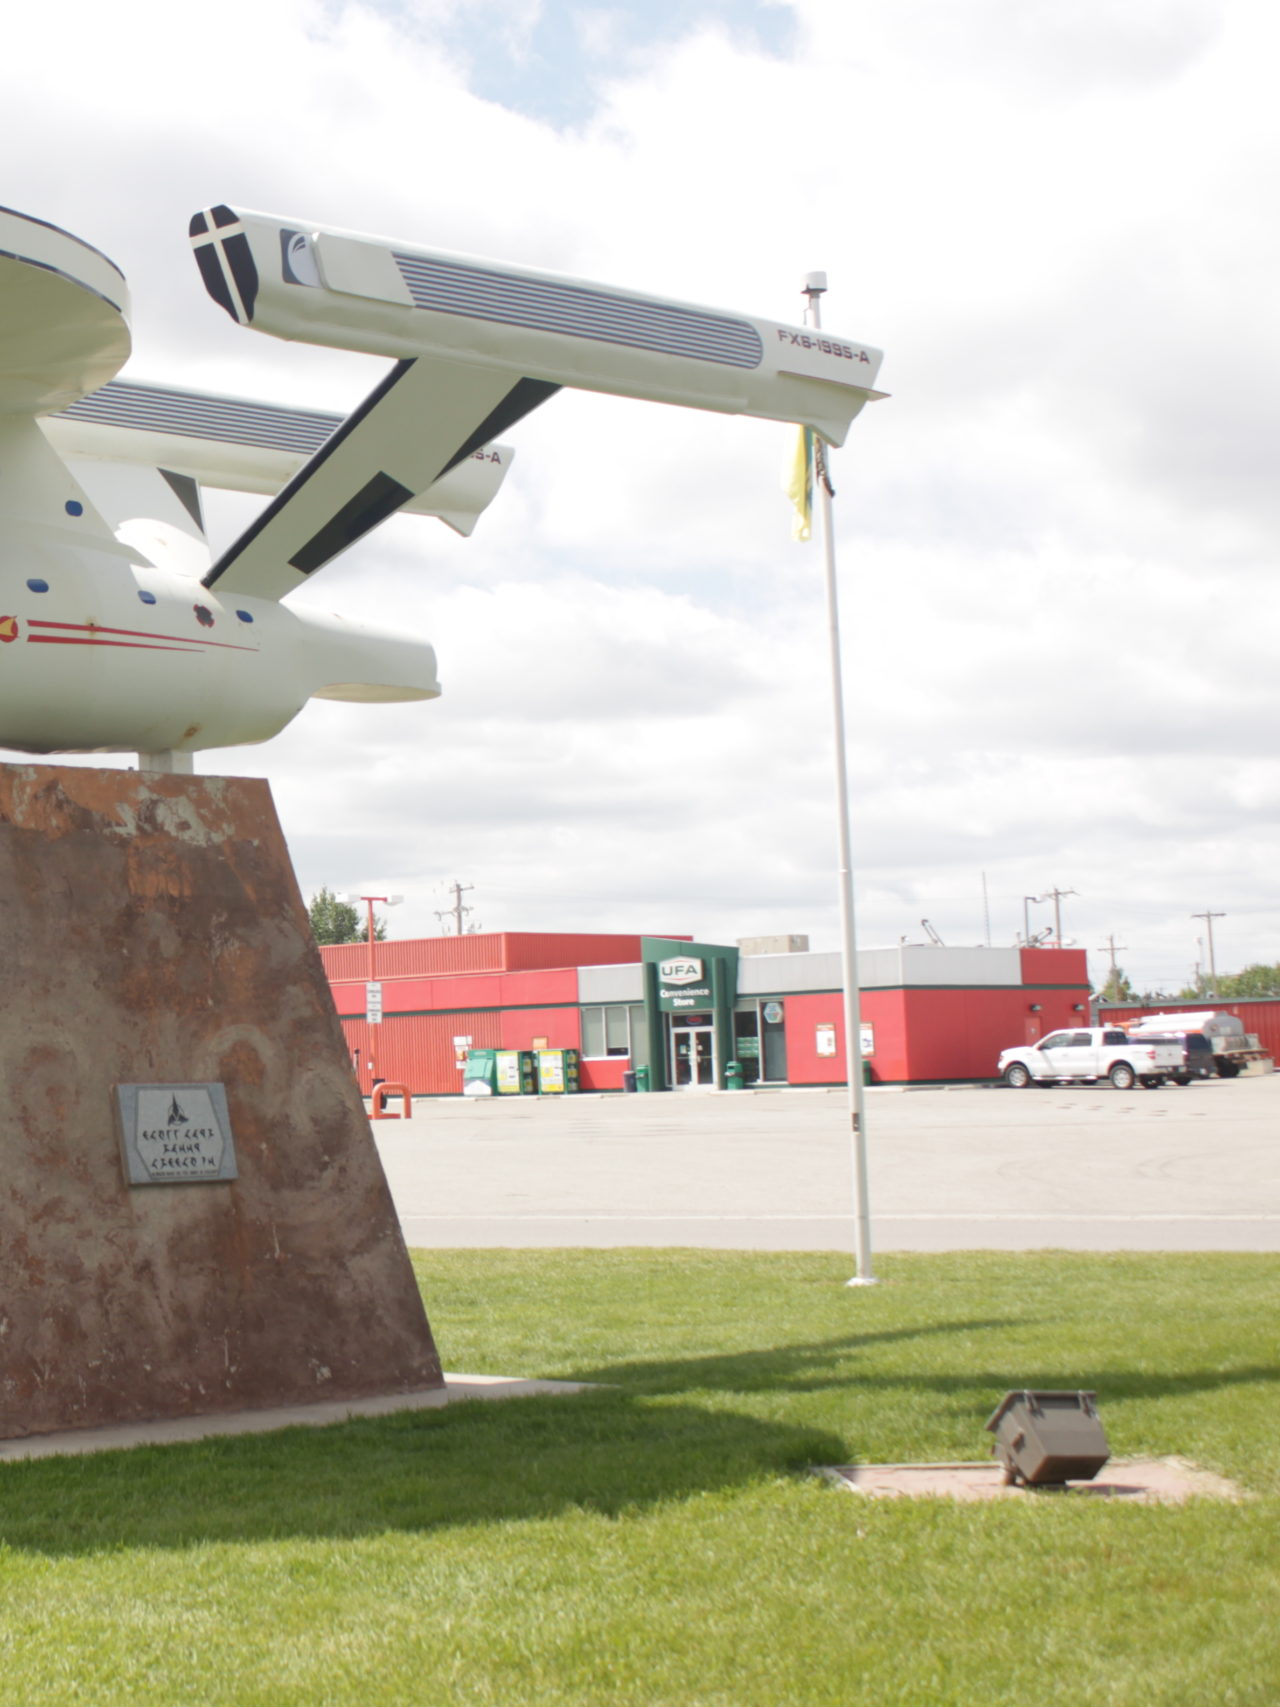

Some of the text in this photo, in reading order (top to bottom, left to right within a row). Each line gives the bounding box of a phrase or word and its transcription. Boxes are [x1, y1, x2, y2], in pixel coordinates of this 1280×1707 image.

[662, 965, 697, 976] UFA
[660, 988, 709, 998] Convenience
[673, 998, 695, 1007] Store
